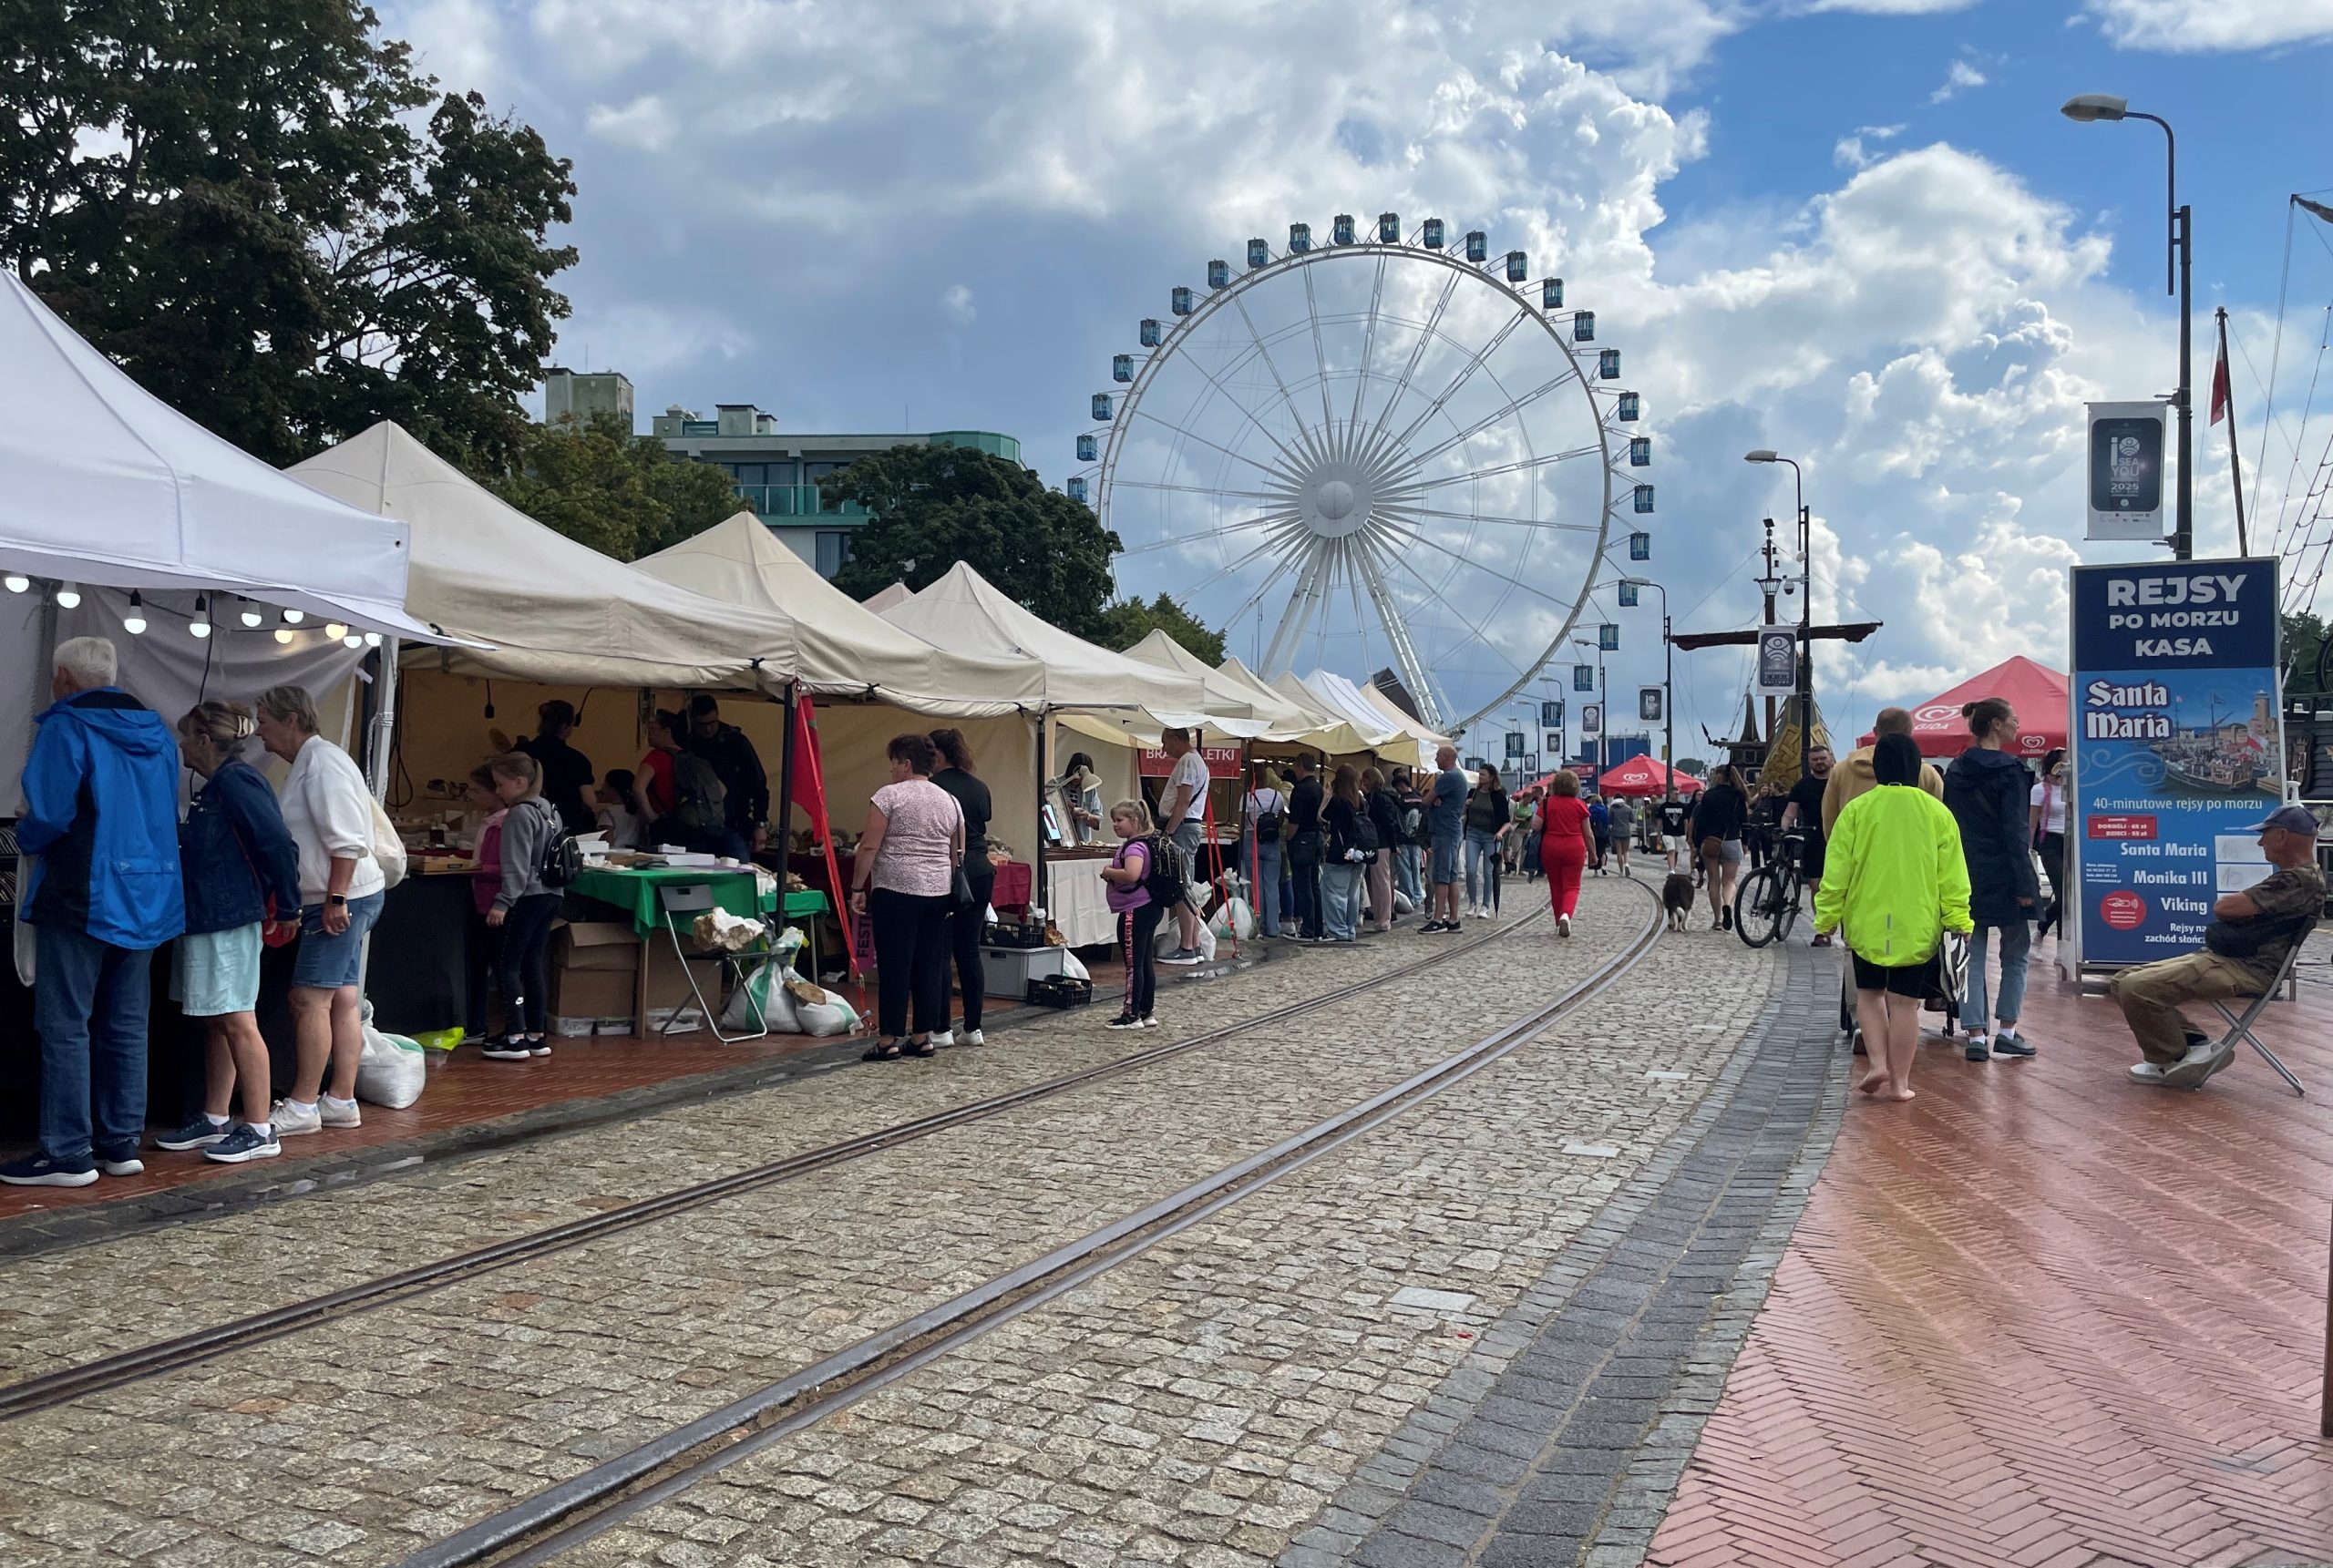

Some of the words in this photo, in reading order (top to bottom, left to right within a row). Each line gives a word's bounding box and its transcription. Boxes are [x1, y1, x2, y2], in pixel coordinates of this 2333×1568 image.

[2119, 457, 2140, 466] SEA
[2111, 466, 2140, 477] YOU
[2107, 574, 2247, 607] REJSY
[2109, 614, 2143, 630] PO
[2150, 610, 2239, 628] MORZU
[2135, 638, 2214, 657] KASA
[2087, 681, 2168, 707] Santa
[2086, 712, 2171, 739] Maria
[2093, 797, 2173, 809] 40-minutowe
[2176, 797, 2204, 813] rejsy
[2207, 799, 2222, 812] po
[2225, 799, 2262, 810] morzu
[2120, 842, 2160, 856] Santa
[2164, 842, 2207, 856] Maria
[2133, 870, 2187, 884] Monika
[2191, 871, 2207, 885] III
[2161, 897, 2208, 916] Viking
[2170, 923, 2194, 934] Rejsy
[2144, 935, 2176, 944] zachód
